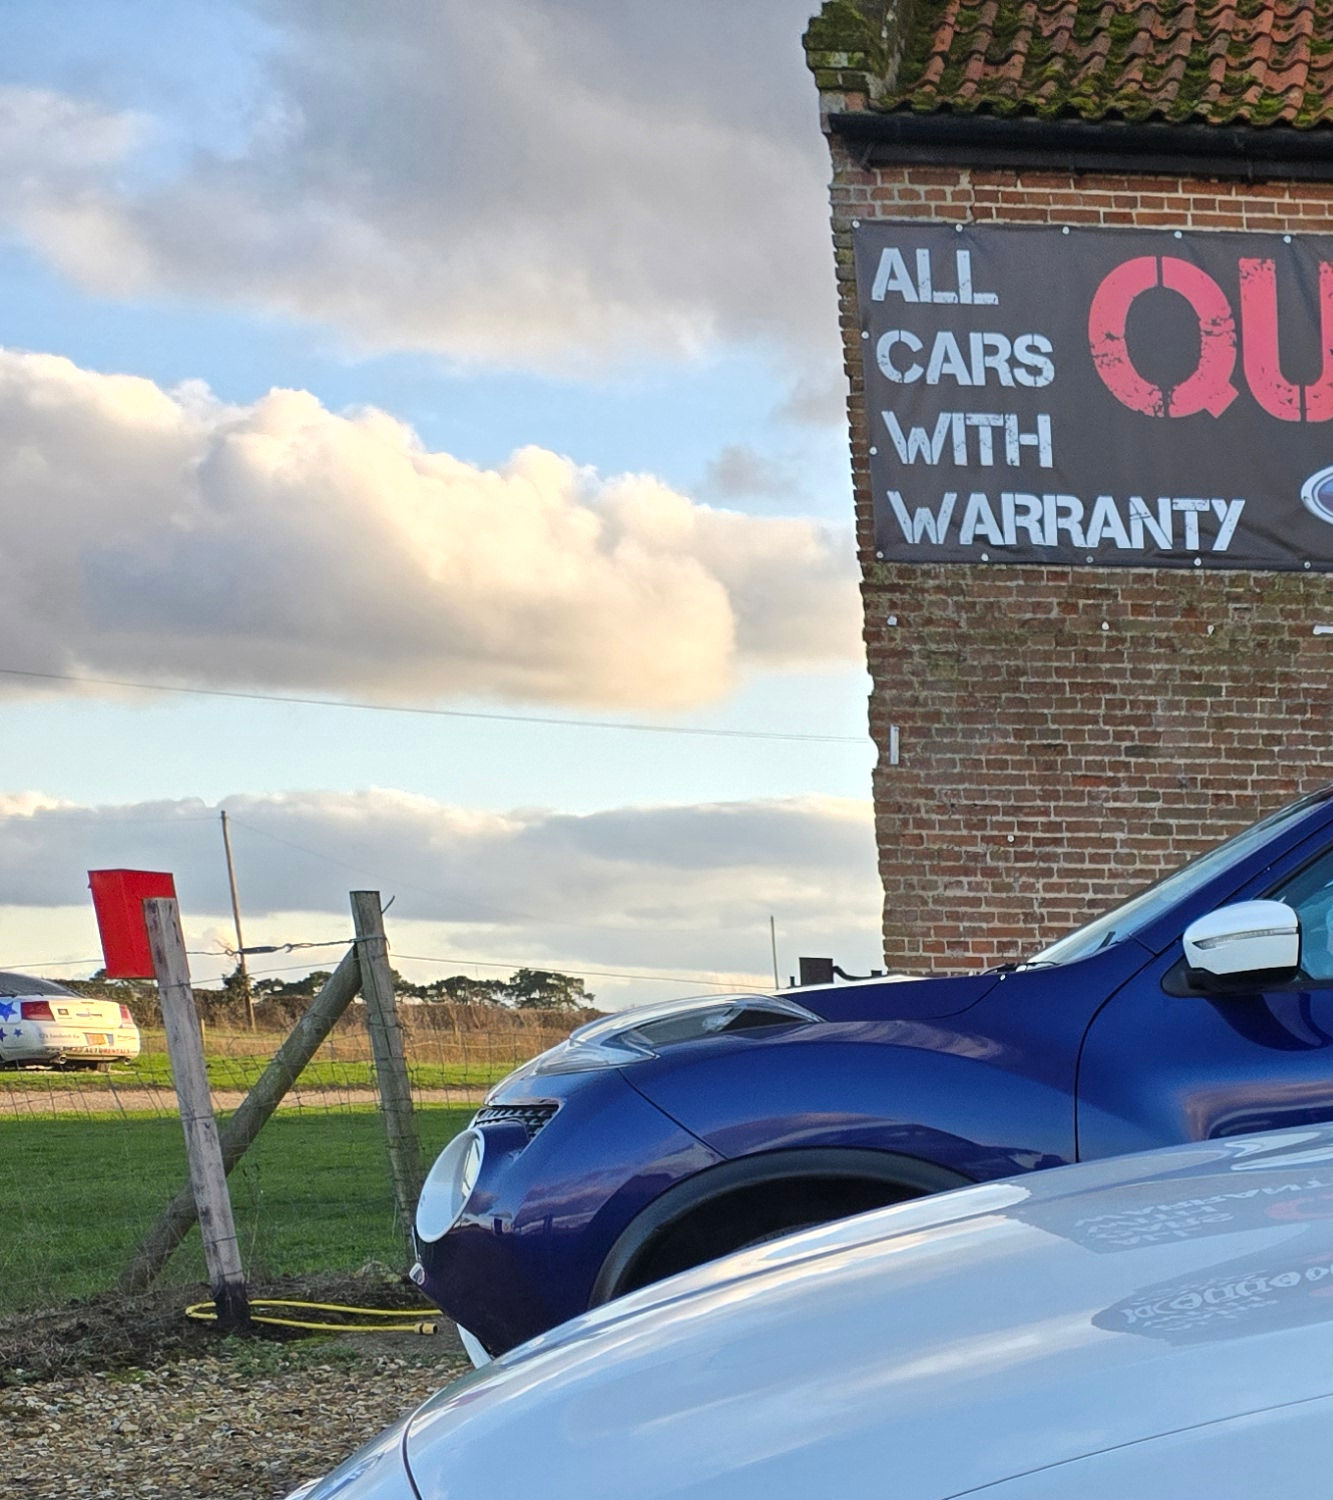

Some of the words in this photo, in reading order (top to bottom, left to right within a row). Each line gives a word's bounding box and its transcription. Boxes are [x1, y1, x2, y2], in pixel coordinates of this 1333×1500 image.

[870, 246, 999, 305] ALL
[875, 330, 1055, 388] CARS
[881, 410, 1053, 468] WITH
[887, 490, 1245, 552] WARRANTY
